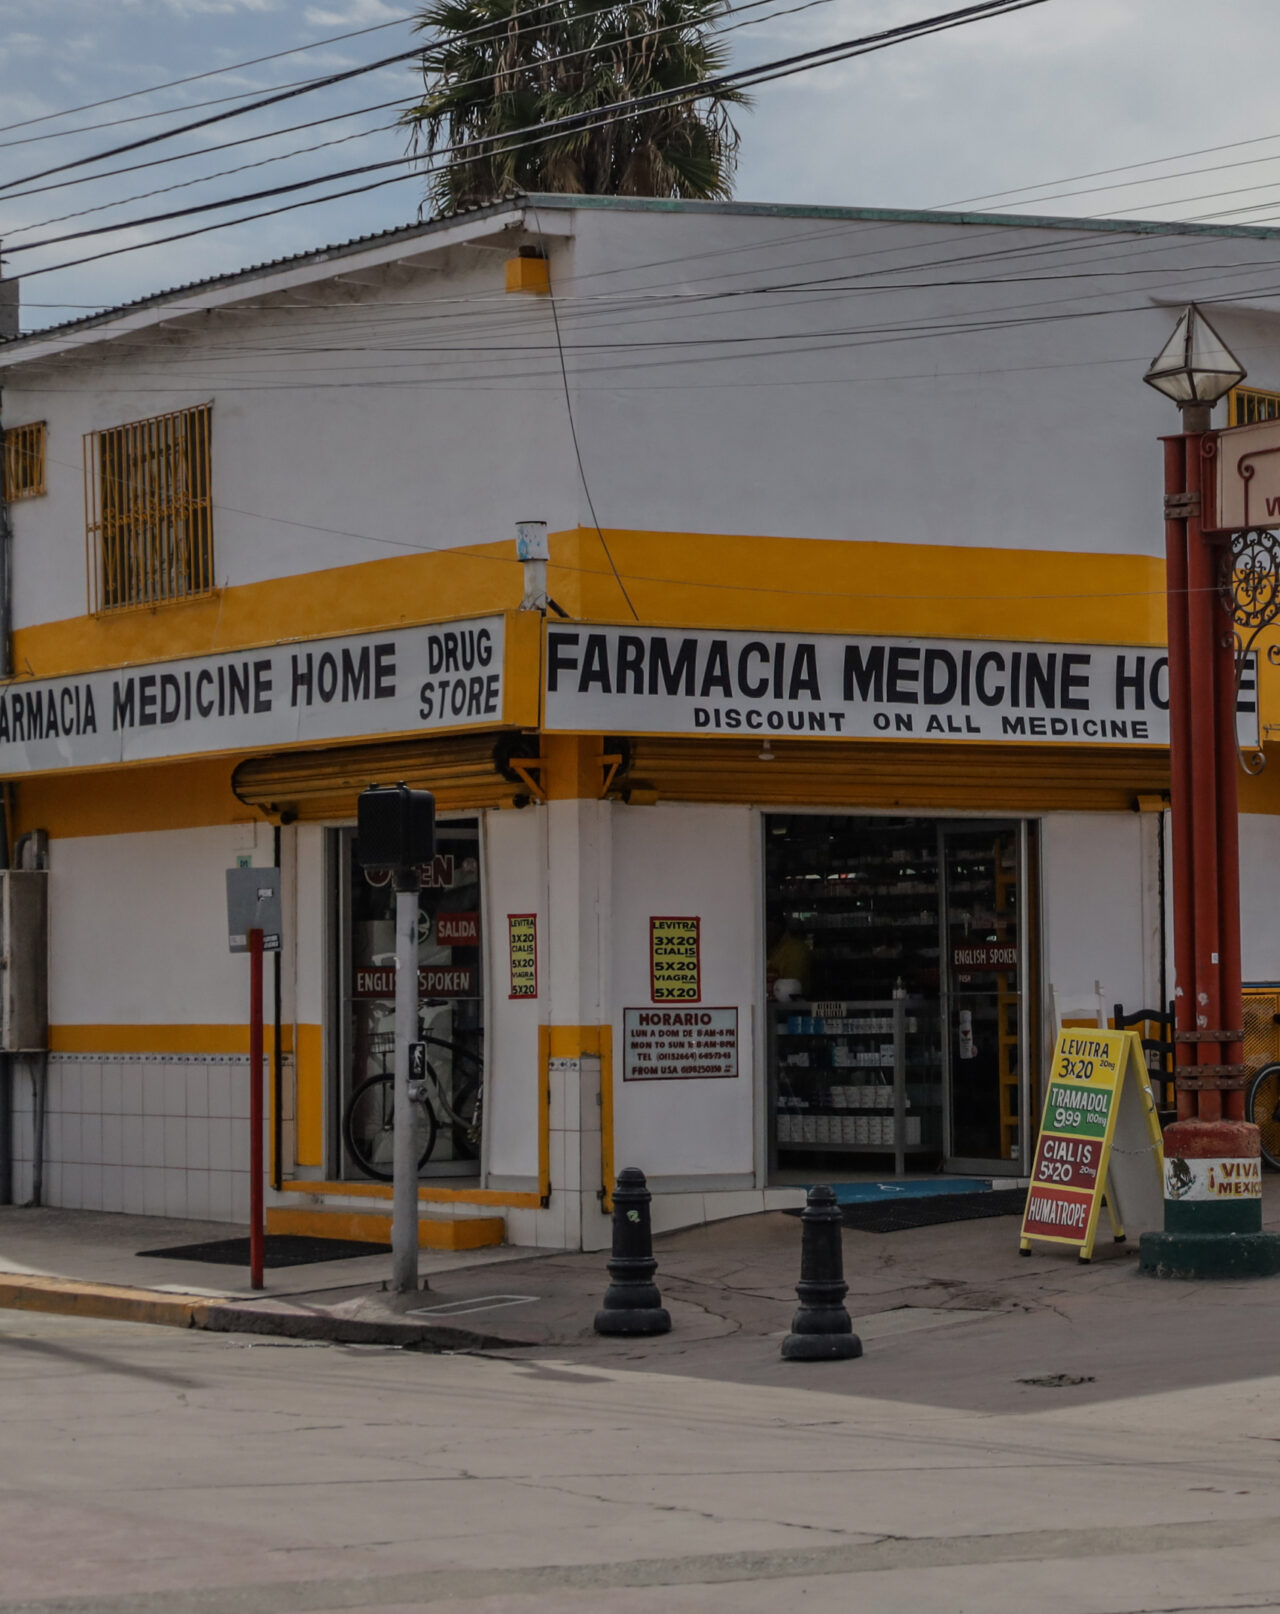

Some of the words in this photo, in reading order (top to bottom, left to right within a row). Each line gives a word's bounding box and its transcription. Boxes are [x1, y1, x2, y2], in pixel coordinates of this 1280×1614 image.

[428, 628, 492, 674] DRUG
[548, 632, 822, 701] FARMACIA
[844, 645, 1091, 711] MEDICINE
[1116, 655, 1255, 713] HOE
[112, 659, 272, 731] MEDICINE
[290, 643, 396, 708] HOME
[420, 674, 500, 720] STORE
[694, 708, 846, 731] DISCOUNT
[873, 713, 913, 732] ON
[926, 713, 981, 733] ALL
[1002, 716, 1149, 739] MEDICINE
[438, 921, 477, 937] SALIDA
[510, 919, 534, 927] LEVITRA
[653, 921, 697, 930] LEVITRA
[655, 937, 697, 946] 3X20
[512, 945, 534, 953] CIALIS
[655, 948, 696, 956] CIALIS
[954, 949, 987, 965] ENGLISH
[989, 948, 1017, 964] SPOKEN
[655, 962, 697, 971] 5X20
[357, 972, 397, 992] ENGLI
[419, 972, 470, 991] SPOKEN
[655, 974, 697, 982] VIAGRA
[655, 988, 697, 998] 5X20
[639, 1013, 712, 1026] HORARIO
[631, 1029, 648, 1038] LUN
[650, 1029, 656, 1037] A
[658, 1029, 680, 1038] DOM
[682, 1029, 693, 1037] DE
[631, 1041, 652, 1049] MON
[655, 1041, 666, 1049] TO
[668, 1041, 685, 1049] SUN
[1060, 1038, 1109, 1059] LEVITRA
[637, 1052, 653, 1061] TEL
[632, 1066, 658, 1076] FROM
[660, 1066, 678, 1075] USA
[1051, 1087, 1108, 1113] TRAMADOL
[1053, 1109, 1081, 1128] 9.99
[1086, 1113, 1107, 1127] 100mg
[1043, 1140, 1092, 1164] CIALIS
[1028, 1197, 1087, 1227] HUMATROPE
